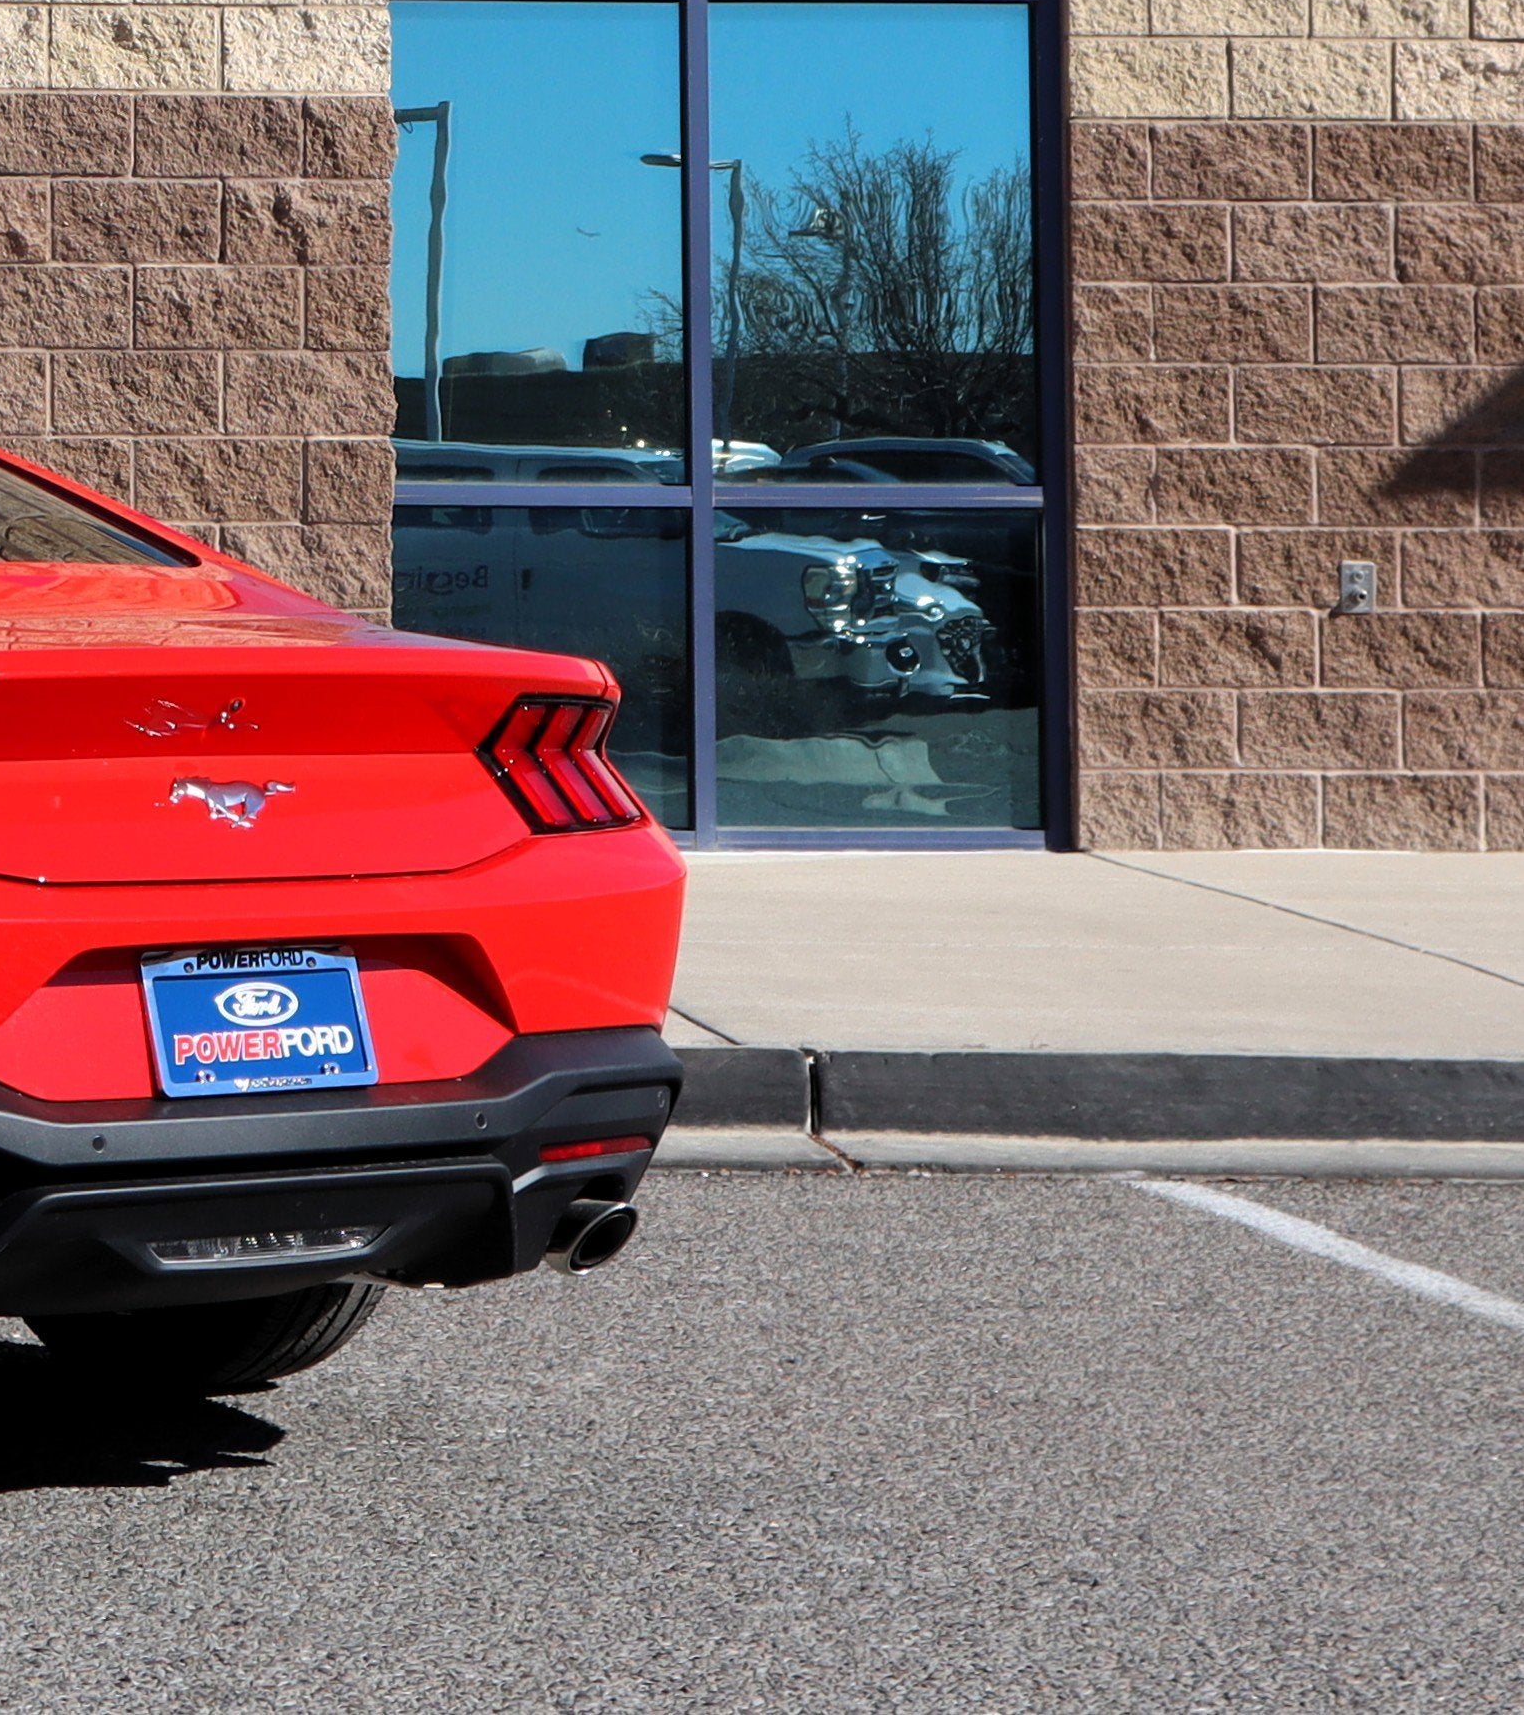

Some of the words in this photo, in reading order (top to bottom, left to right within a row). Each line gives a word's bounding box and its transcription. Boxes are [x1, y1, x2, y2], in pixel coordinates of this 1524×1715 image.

[197, 950, 304, 970] POWERFORD
[233, 990, 281, 1016] Ford
[174, 1026, 354, 1065] POWERFORD
